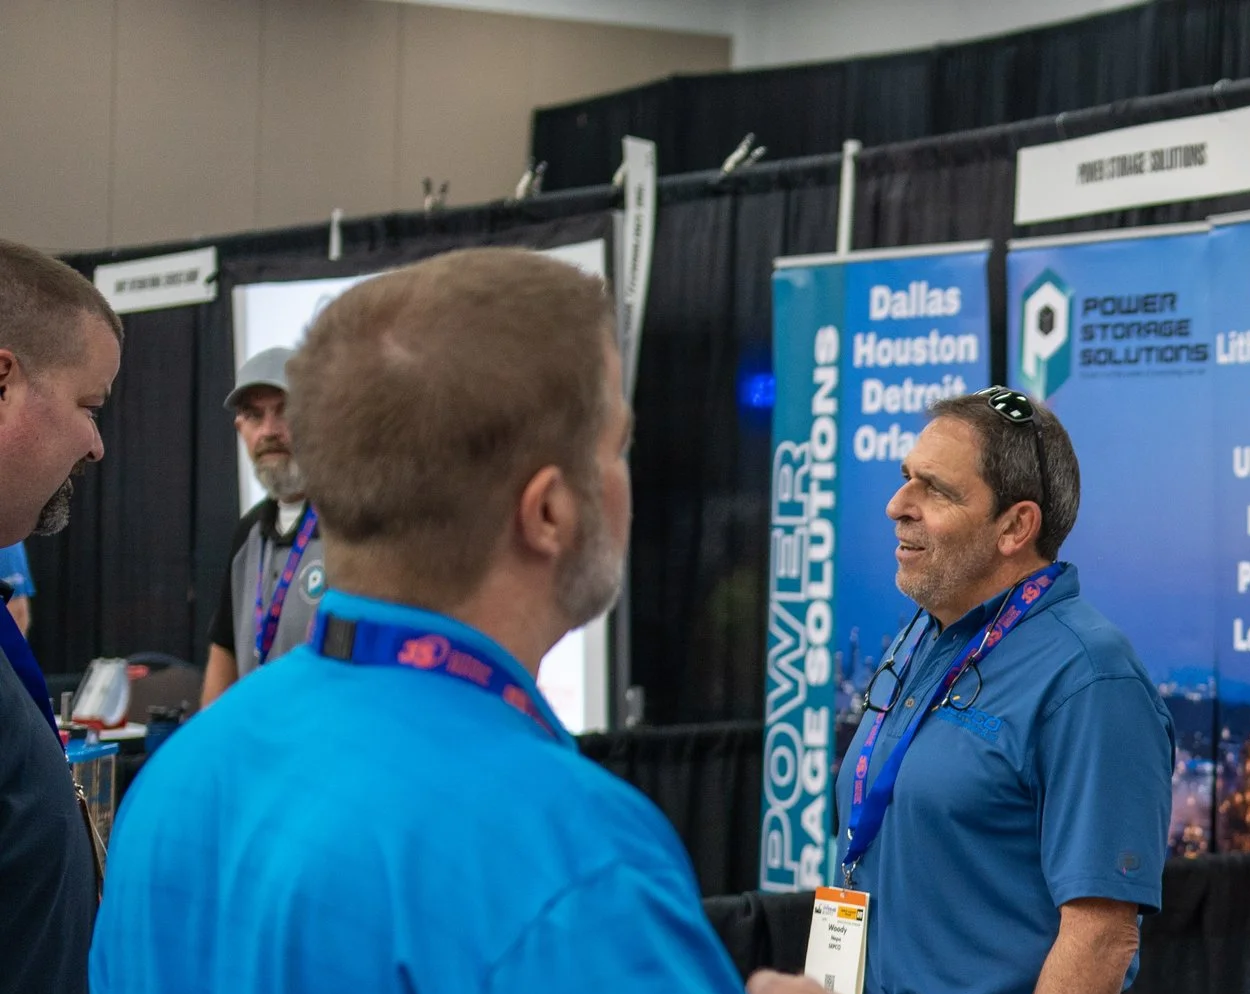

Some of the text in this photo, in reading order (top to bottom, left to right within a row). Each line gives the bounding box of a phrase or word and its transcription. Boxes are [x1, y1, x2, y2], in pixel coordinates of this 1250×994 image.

[869, 281, 961, 320] Dallas
[1082, 292, 1177, 317] POWER
[1081, 317, 1191, 342] STORAGE
[853, 329, 979, 368] Houston
[1079, 343, 1209, 366] SOLUTIONS
[862, 376, 966, 413] Detroit
[804, 324, 840, 686] SOLUTIONS
[759, 440, 812, 894] POWER
[828, 923, 848, 935] Woody
